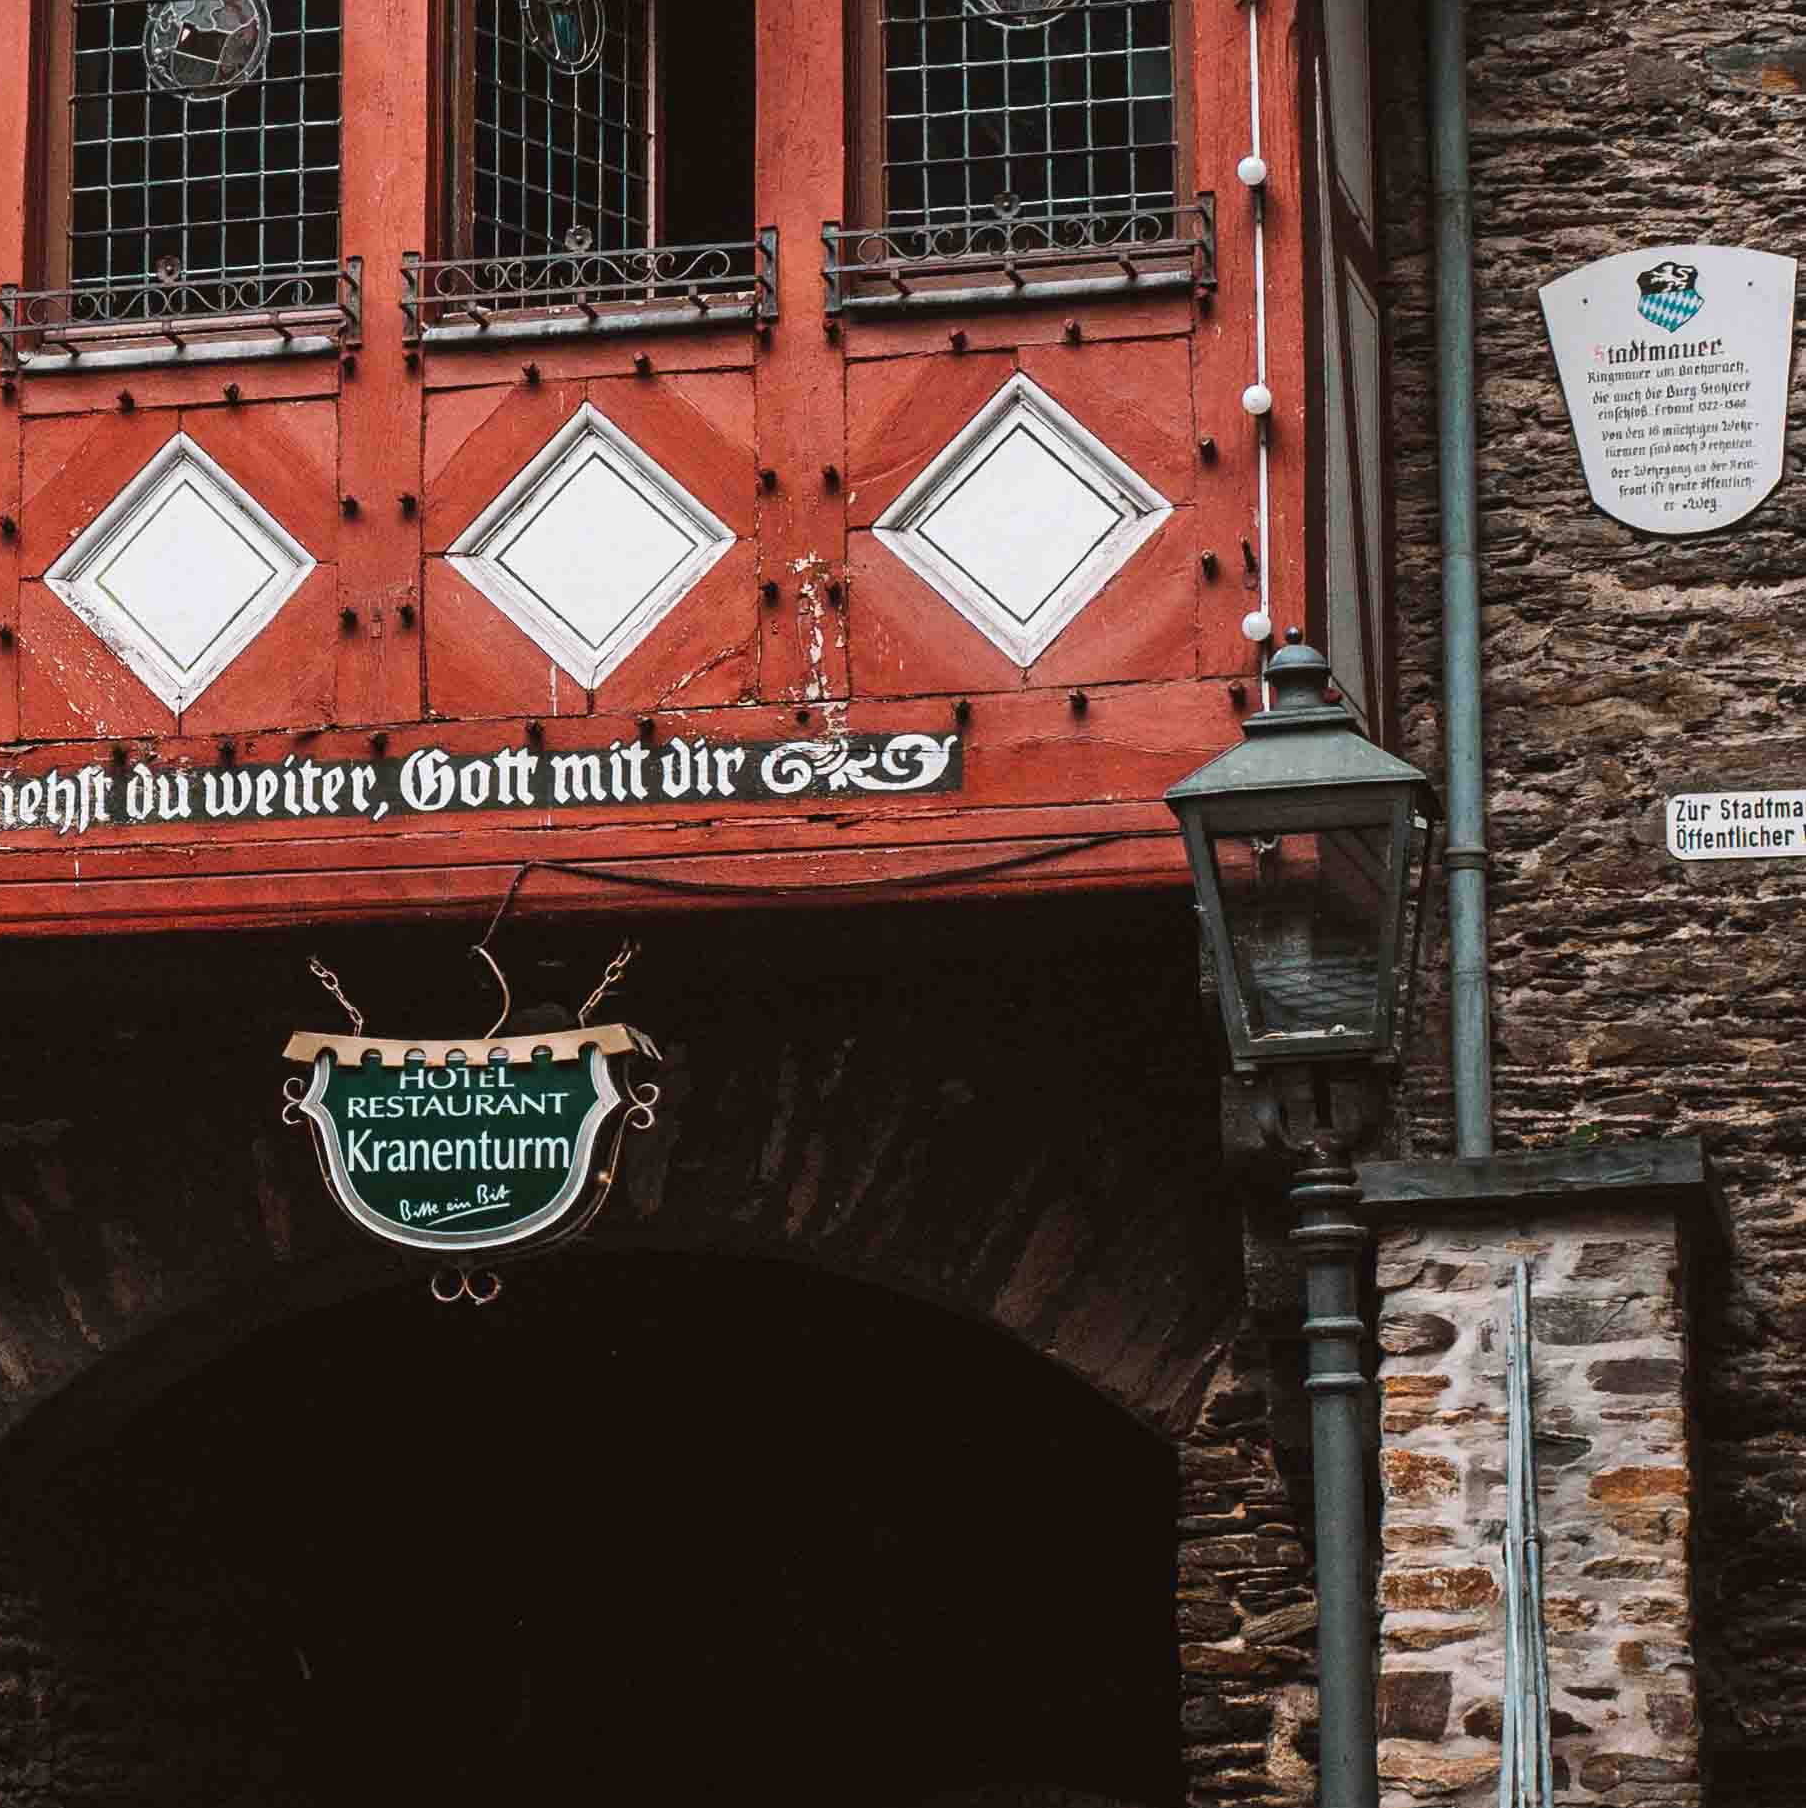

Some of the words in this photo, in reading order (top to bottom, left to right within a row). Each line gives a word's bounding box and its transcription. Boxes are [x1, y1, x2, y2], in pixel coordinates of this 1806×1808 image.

[1593, 338, 1724, 364] Stadtmauer
[1587, 370, 1651, 386] Ringmauer
[1656, 367, 1675, 379] um
[1592, 390, 1610, 405] die
[1613, 390, 1642, 405] auch
[1645, 387, 1662, 401] die
[1666, 384, 1697, 400] Burg
[1625, 427, 1645, 439] den
[1673, 442, 1698, 454] noch
[125, 762, 193, 824] du
[204, 754, 389, 822] weiter,
[400, 747, 539, 812] Gott
[550, 738, 651, 805] mit
[659, 735, 746, 799] dir
[1720, 797, 1806, 821] Stadtma
[1676, 824, 1795, 850] Öffentlicher
[399, 1065, 515, 1090] HOTEL
[347, 1092, 570, 1119] RESTAURANT
[347, 1127, 571, 1173] Kranenturm
[399, 1199, 440, 1222] Bitte
[446, 1198, 472, 1211] ein
[476, 1183, 513, 1205] Bit
